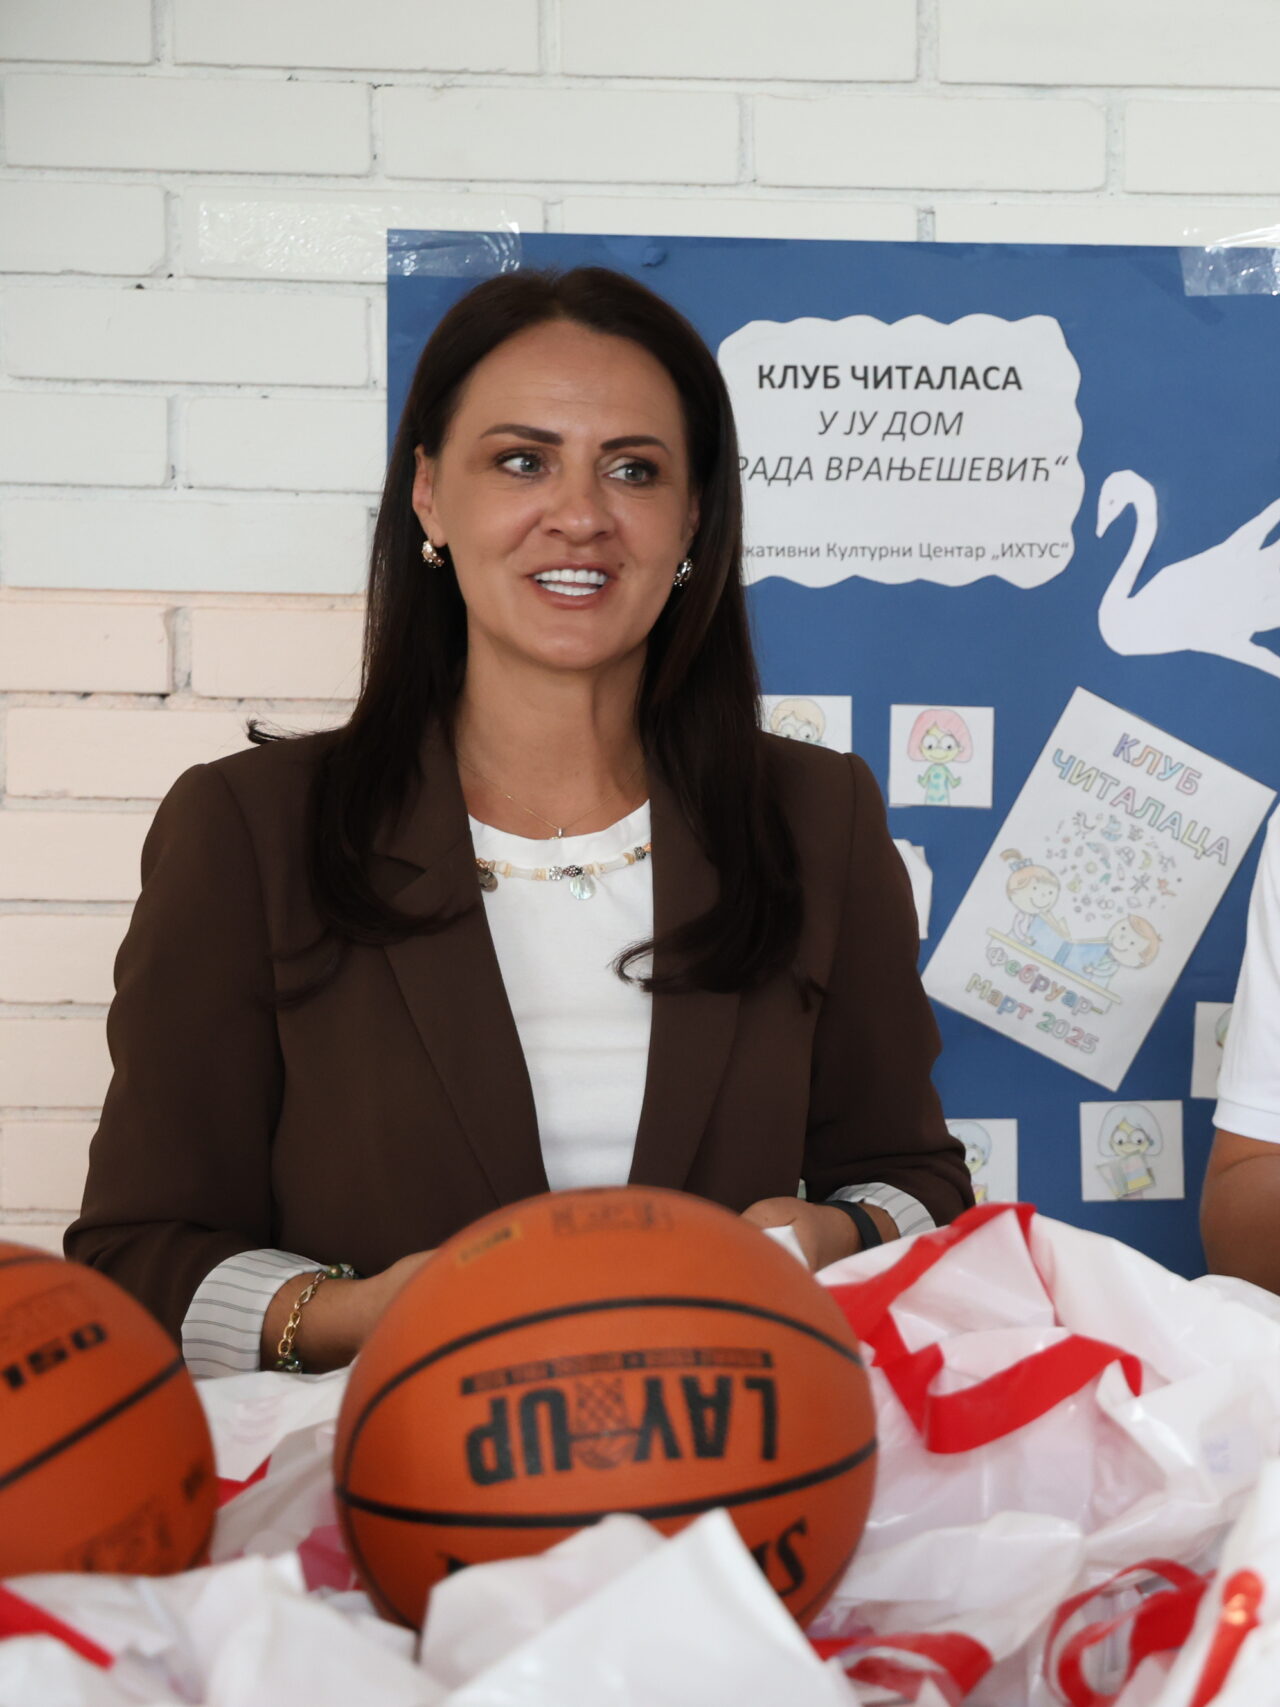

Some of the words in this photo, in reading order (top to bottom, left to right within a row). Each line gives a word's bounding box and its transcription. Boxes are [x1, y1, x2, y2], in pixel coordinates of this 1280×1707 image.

[757, 364, 841, 390] КЛУБ
[850, 364, 1023, 391] ЧИТАЛАСА
[817, 410, 839, 436] У
[881, 410, 964, 442] ДОМ
[741, 544, 821, 558] кативни
[826, 542, 913, 562] Културни
[918, 542, 986, 561] Центар
[1112, 732, 1203, 796] КЛУБ
[1052, 748, 1230, 866] ЧИТАЛАЦА
[965, 972, 1034, 1020] Март
[1035, 1011, 1100, 1055] 2025
[464, 1386, 573, 1487] UP
[632, 1374, 778, 1462] LAY
